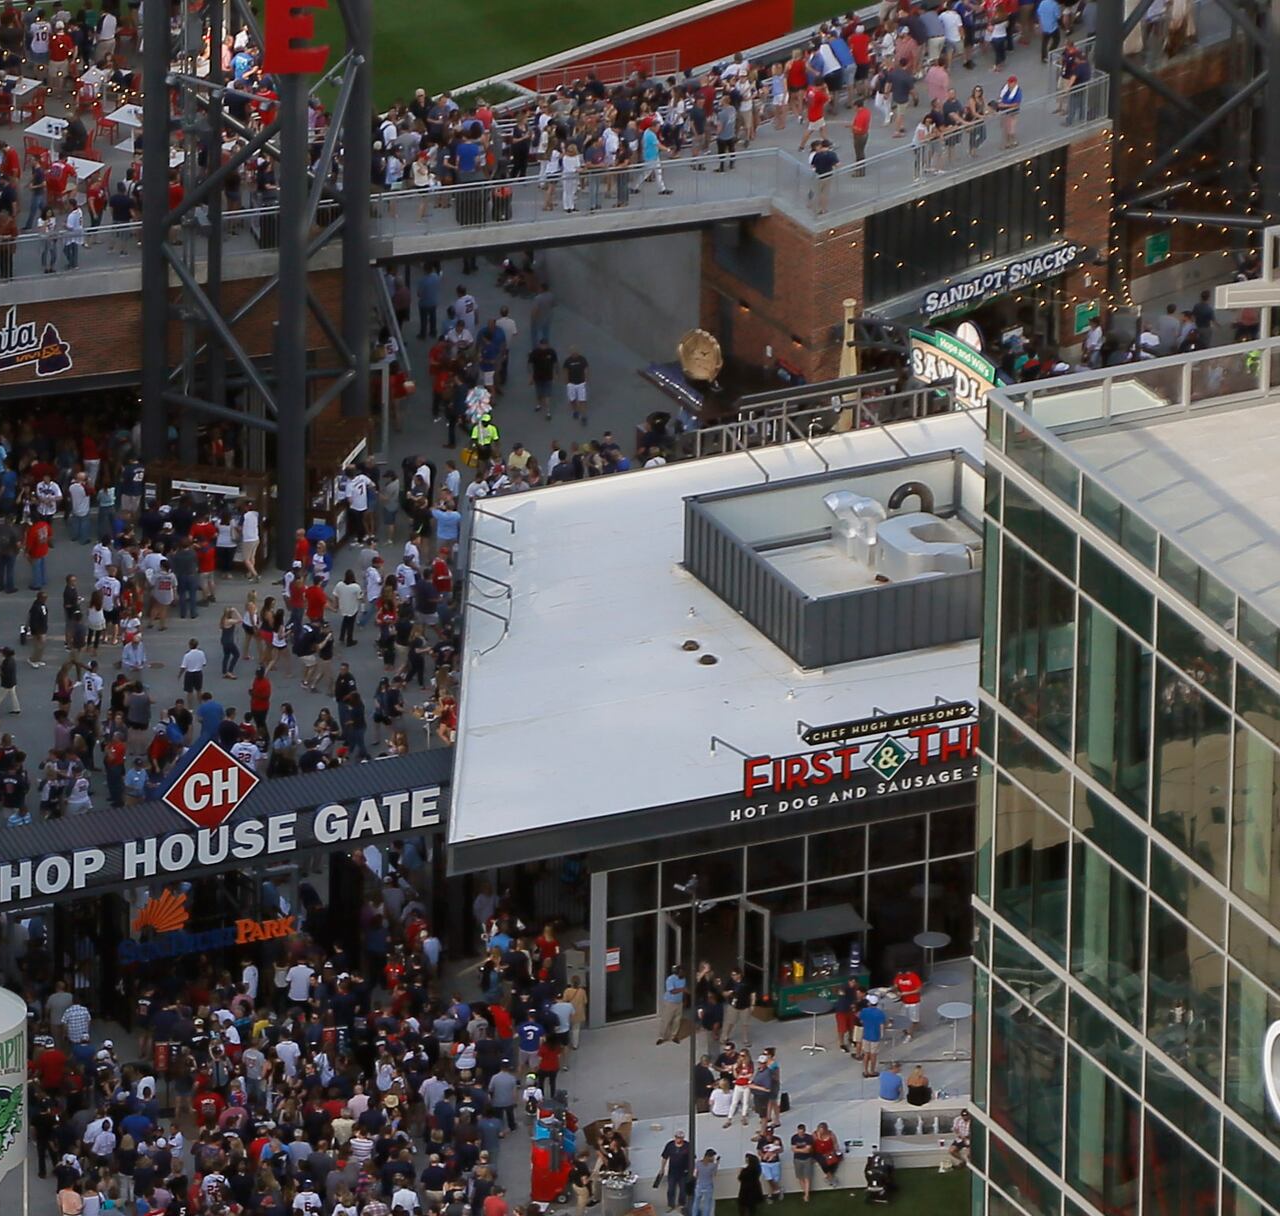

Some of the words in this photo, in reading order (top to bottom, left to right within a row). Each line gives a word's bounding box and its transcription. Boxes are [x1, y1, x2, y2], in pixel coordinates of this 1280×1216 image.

[925, 271, 1008, 313] SANDLOT
[1008, 245, 1078, 285] SNACKS
[812, 727, 846, 742] CHEF
[851, 720, 889, 736] HUGH
[893, 706, 968, 728] ACHESON'S
[182, 765, 240, 812] CH
[730, 803, 770, 822] HOT
[778, 795, 820, 813] DOG
[828, 786, 868, 804] AND
[876, 768, 963, 795] SAUSAGE
[743, 744, 861, 799] FIRST
[877, 745, 900, 770] &
[123, 812, 298, 880] HOUSE
[313, 786, 441, 845] GATE
[234, 915, 298, 945] PARK
